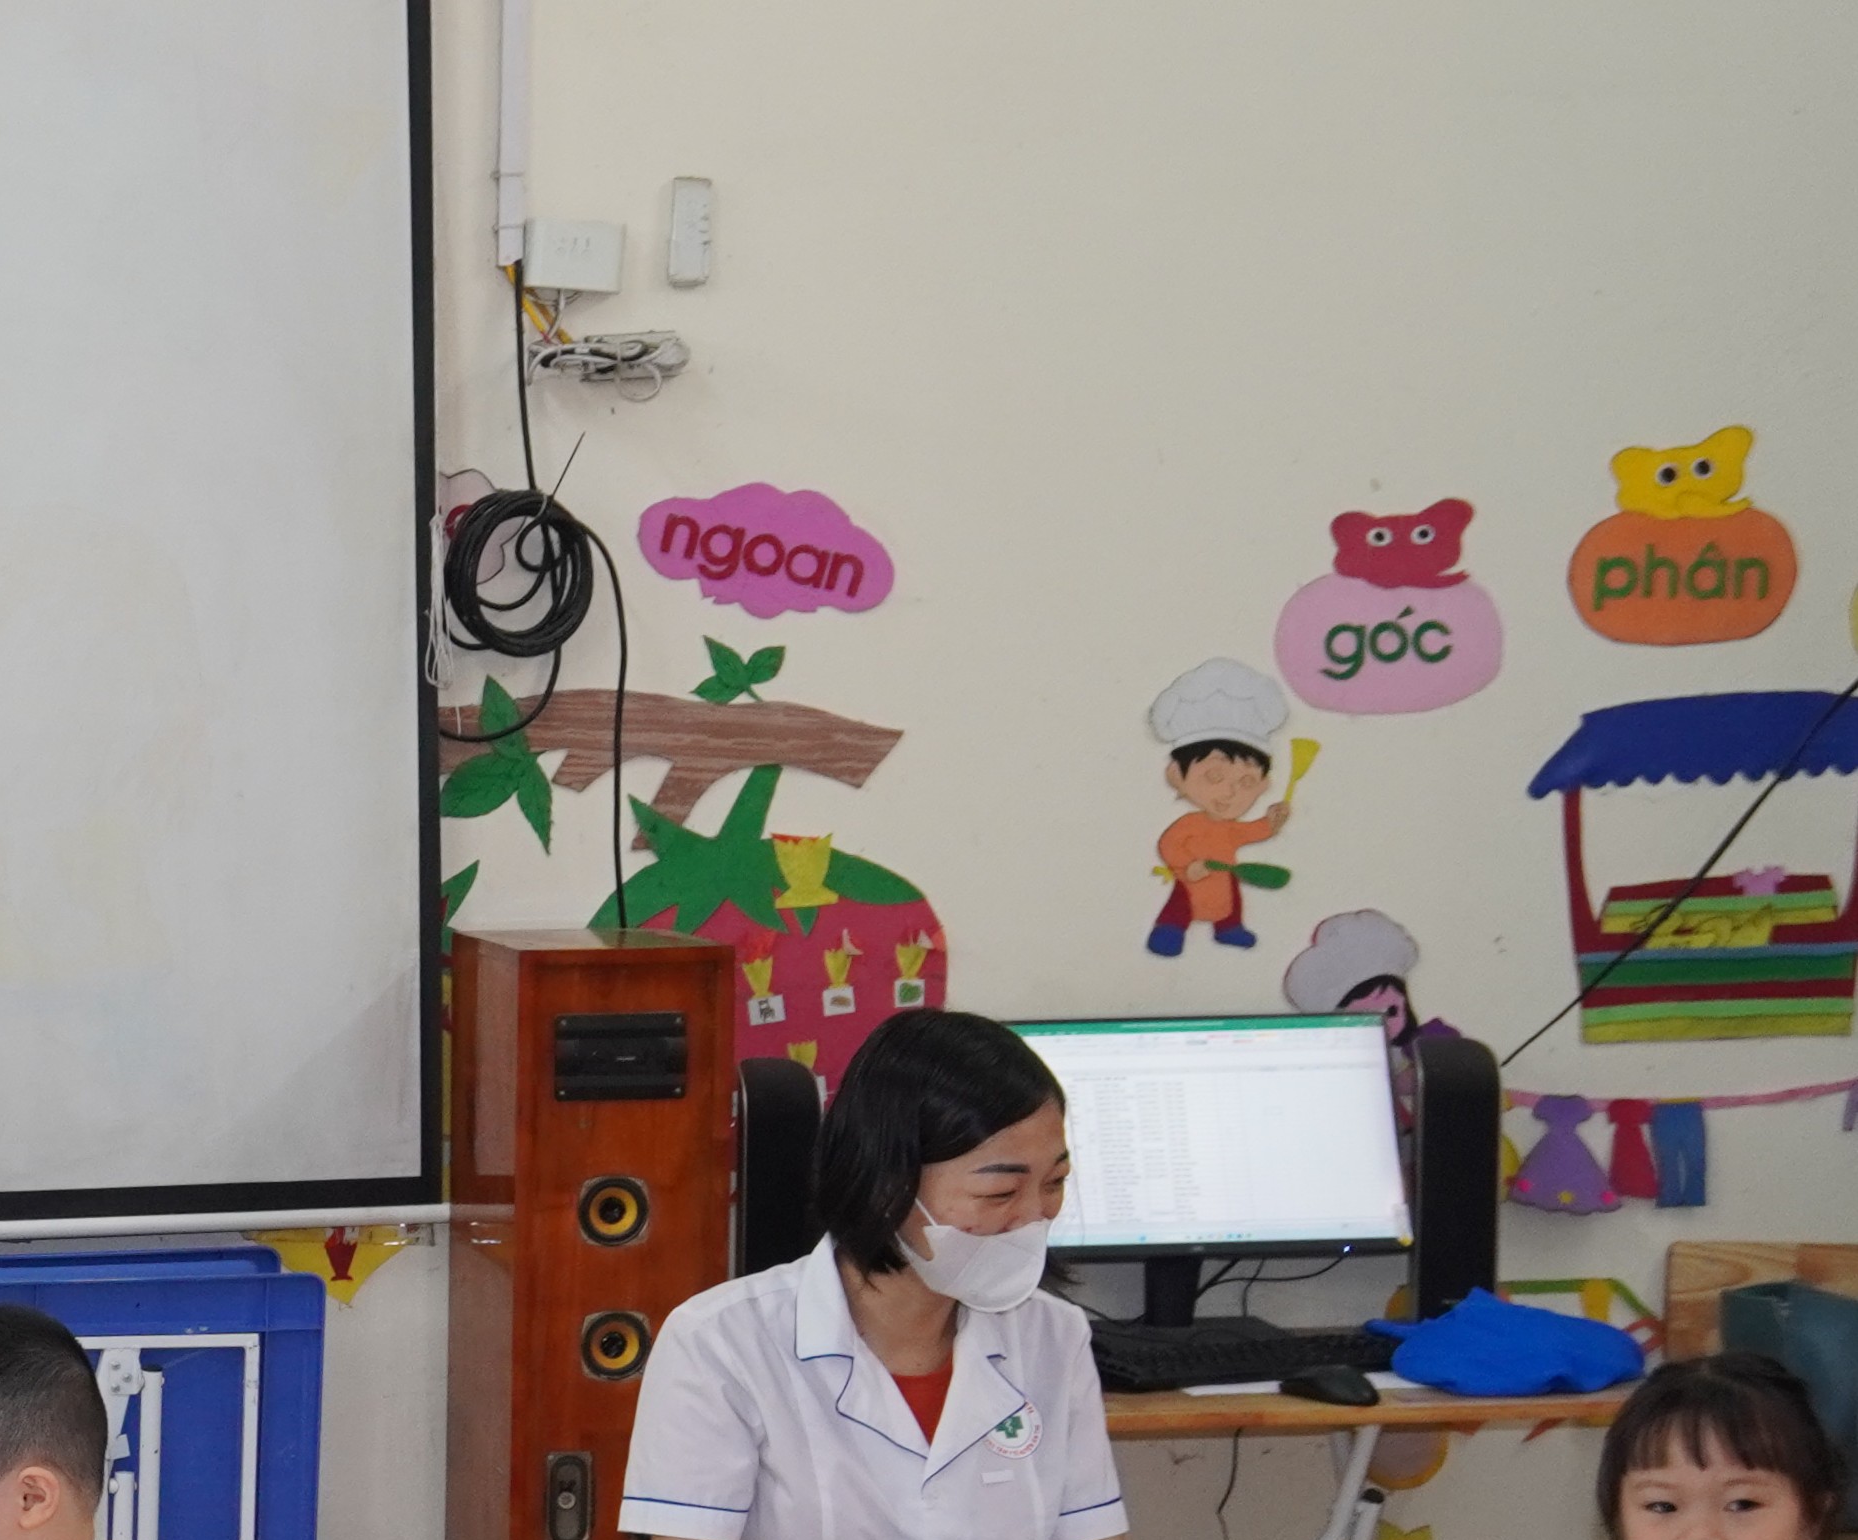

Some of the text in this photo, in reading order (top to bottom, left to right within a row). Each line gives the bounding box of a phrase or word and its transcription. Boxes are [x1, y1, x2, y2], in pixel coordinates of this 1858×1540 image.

[660, 513, 864, 598] ngoan
[1320, 541, 1770, 681] góc phân
